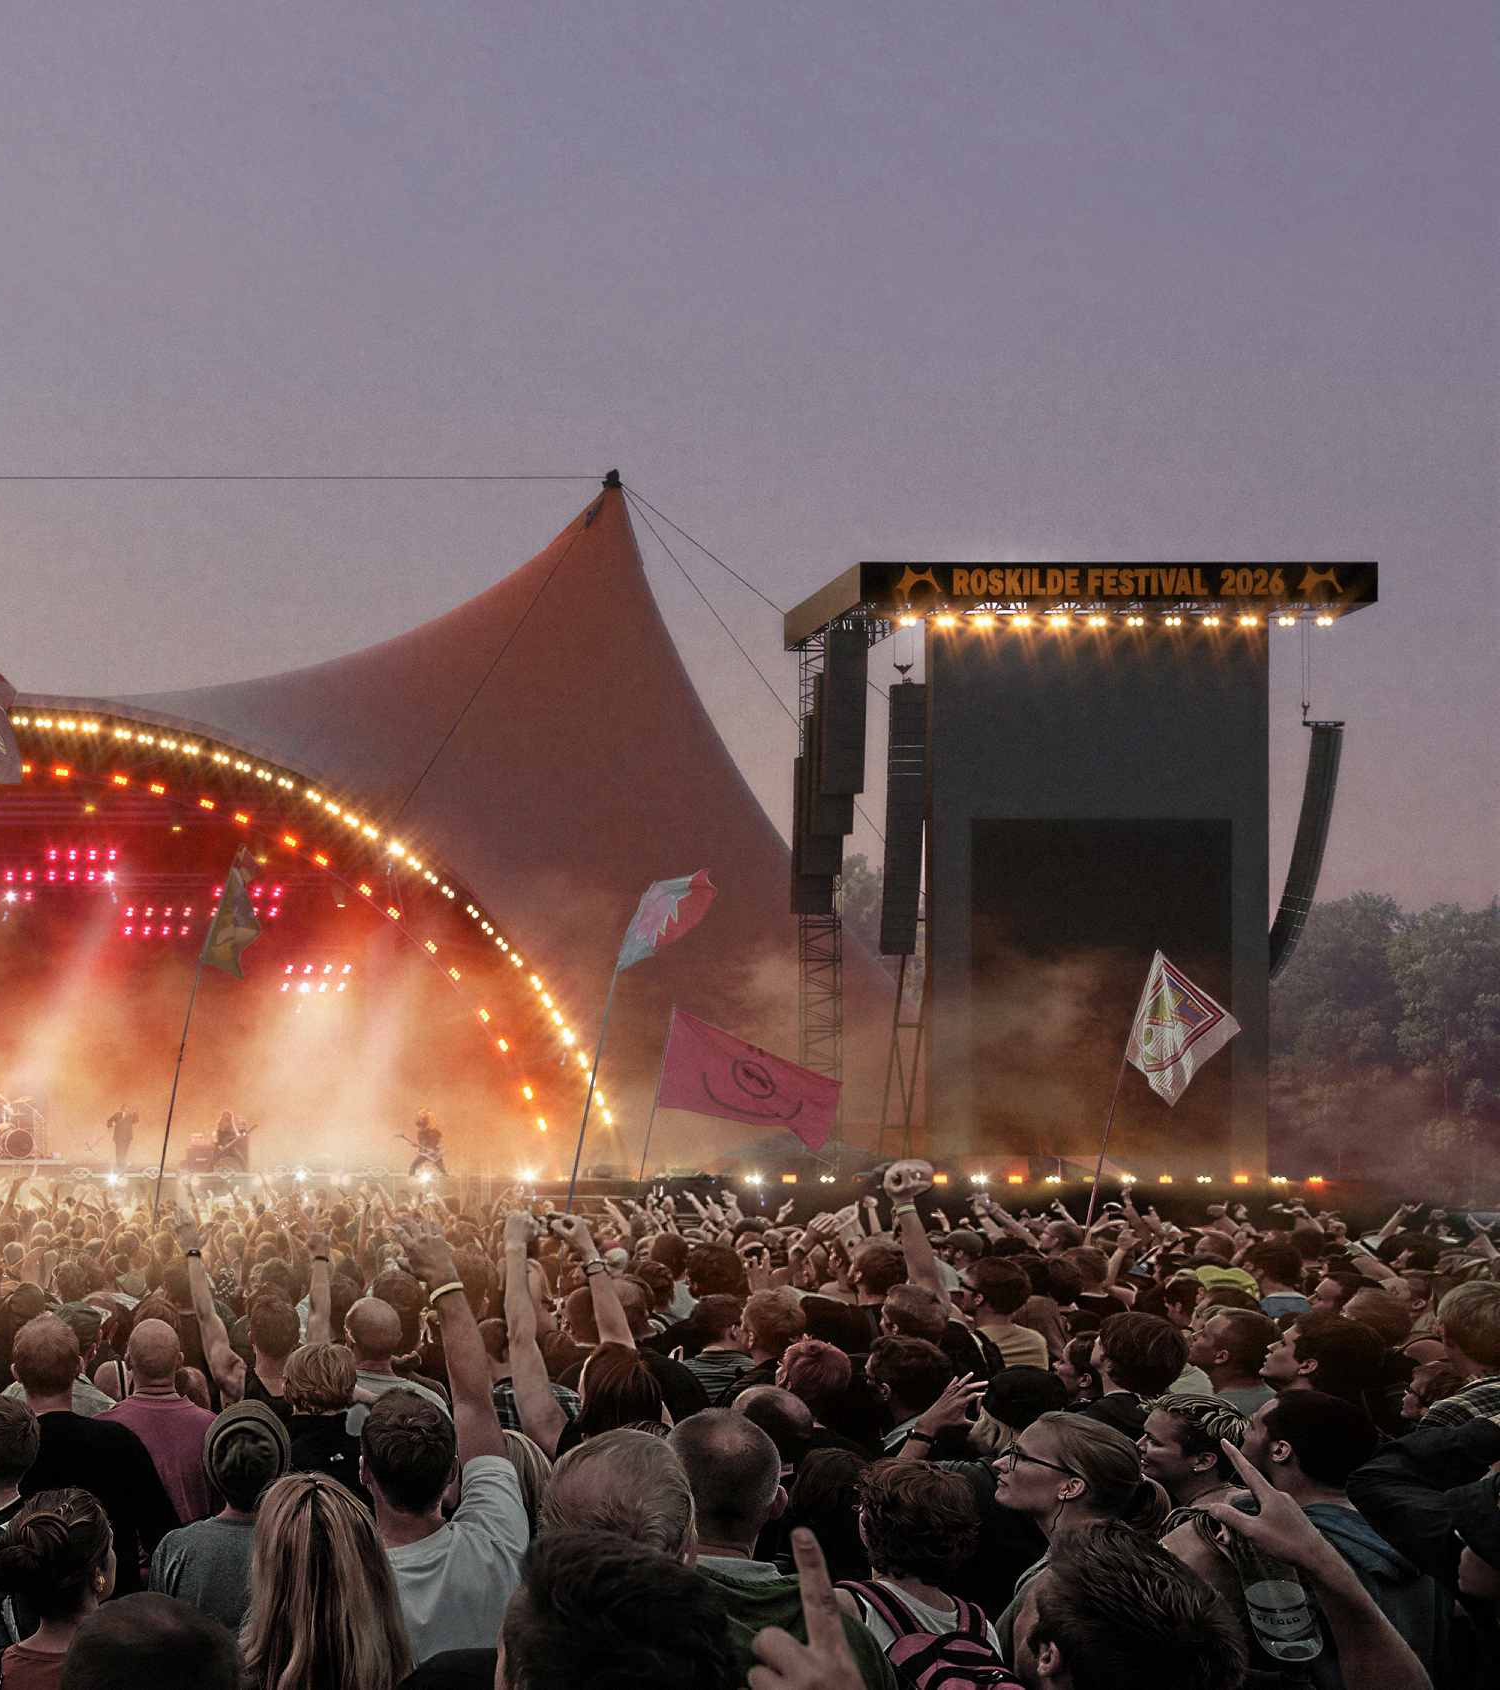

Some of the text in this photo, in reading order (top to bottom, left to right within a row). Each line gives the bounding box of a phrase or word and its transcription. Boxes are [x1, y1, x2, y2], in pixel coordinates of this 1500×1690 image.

[952, 567, 1285, 596] ROSKILDE FESTIVAL 2026
